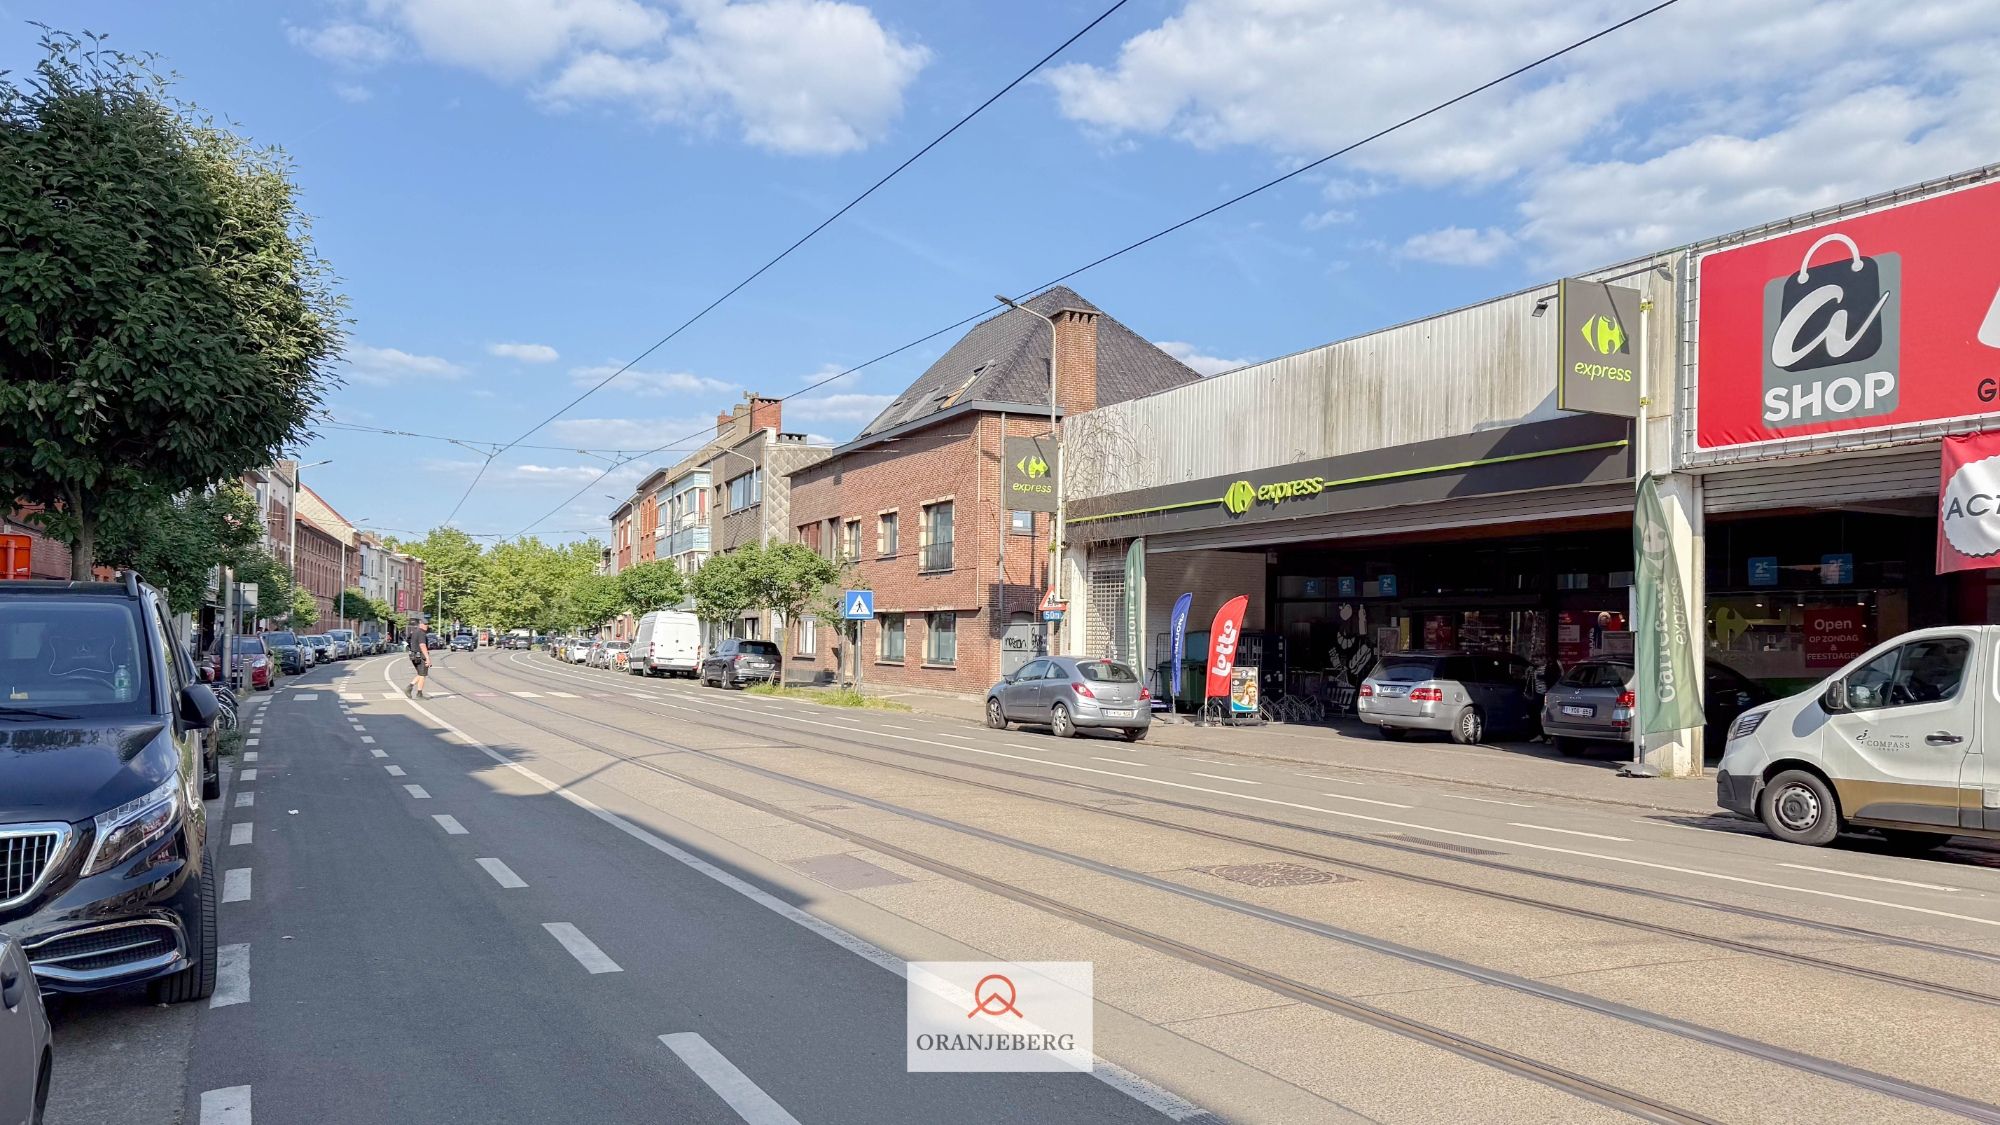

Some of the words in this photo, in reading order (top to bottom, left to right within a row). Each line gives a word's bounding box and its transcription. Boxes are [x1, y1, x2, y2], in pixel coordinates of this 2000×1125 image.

[1574, 361, 1632, 383] express
[1763, 371, 1895, 422] SHOP
[1012, 481, 1052, 493] express
[1258, 477, 1323, 503] express
[1670, 577, 1688, 645] express
[1814, 620, 1852, 632] Open
[1822, 634, 1859, 643] ZONDAG
